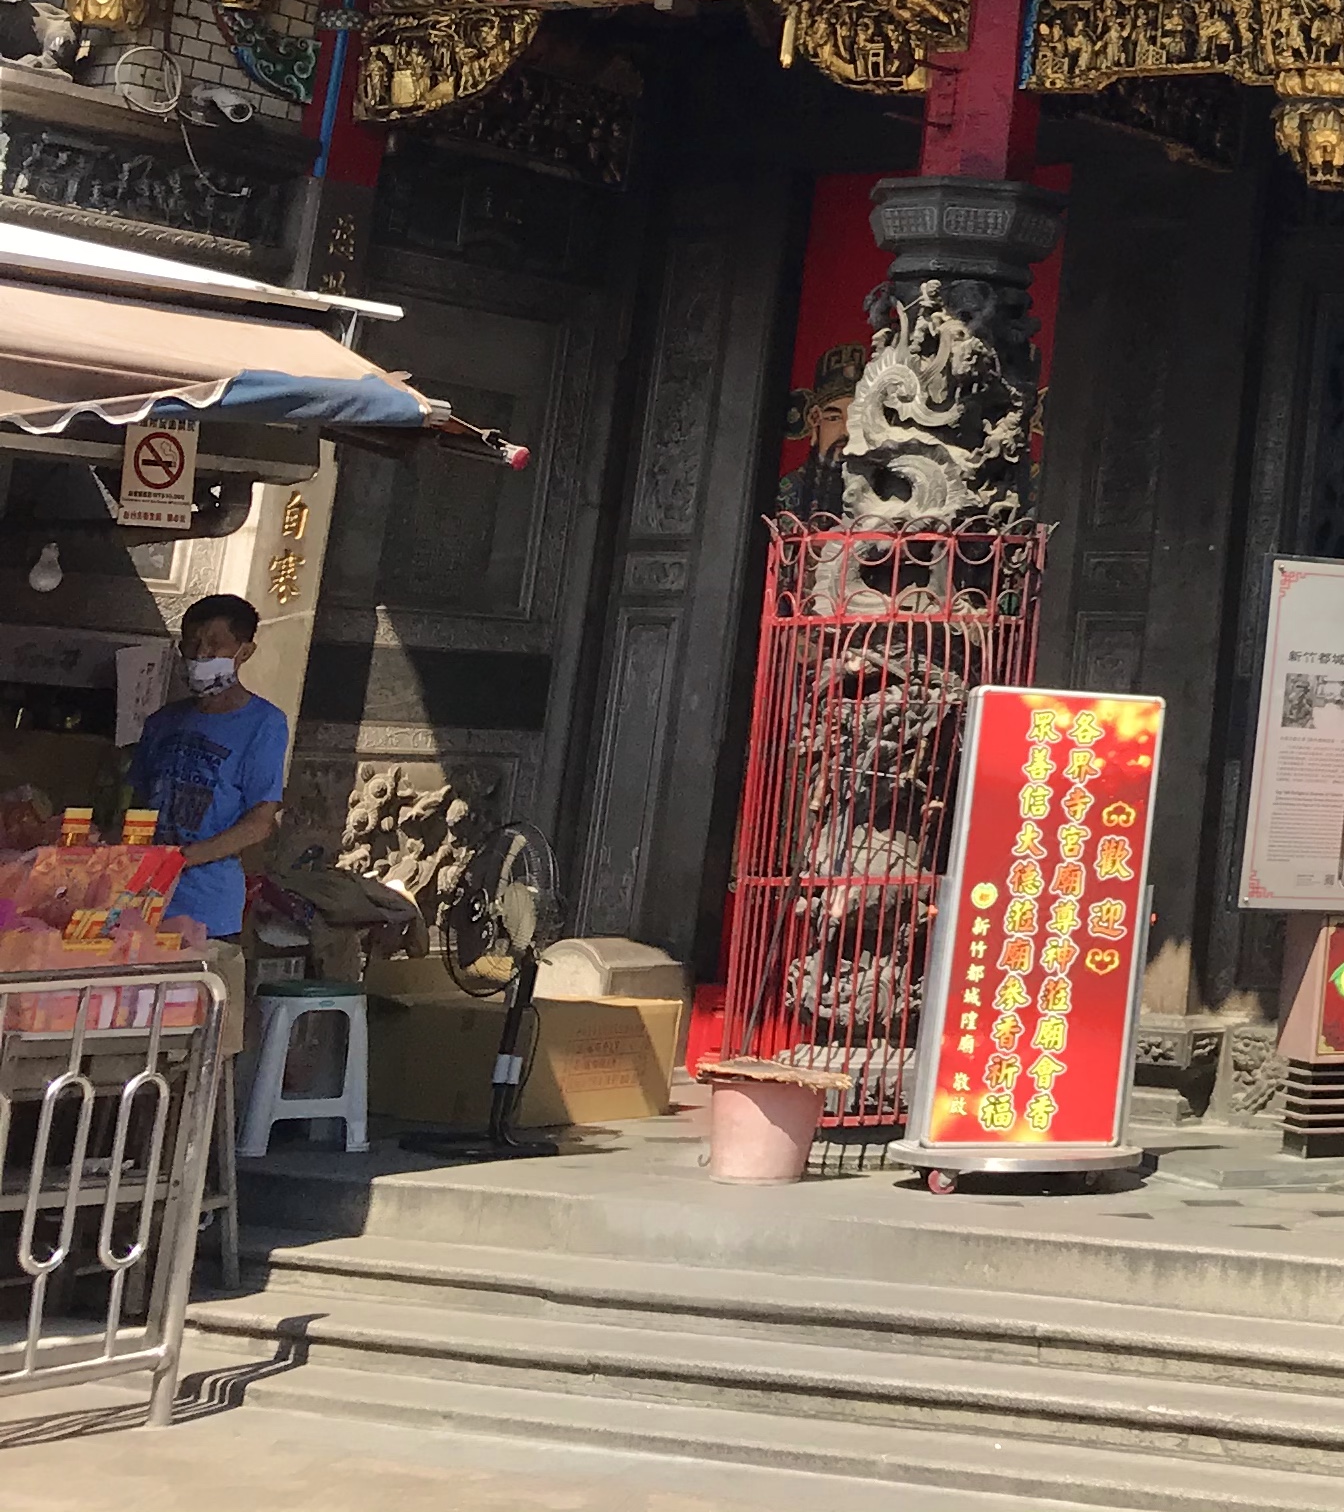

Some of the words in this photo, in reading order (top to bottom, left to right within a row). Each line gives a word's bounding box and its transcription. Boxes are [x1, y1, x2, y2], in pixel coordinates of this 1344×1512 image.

[1025, 709, 1105, 1132] 各界寺宮廟尊神蒞廟會香
[1086, 834, 1134, 939] 歡迎
[958, 915, 991, 1056] 新竹都城隍廟
